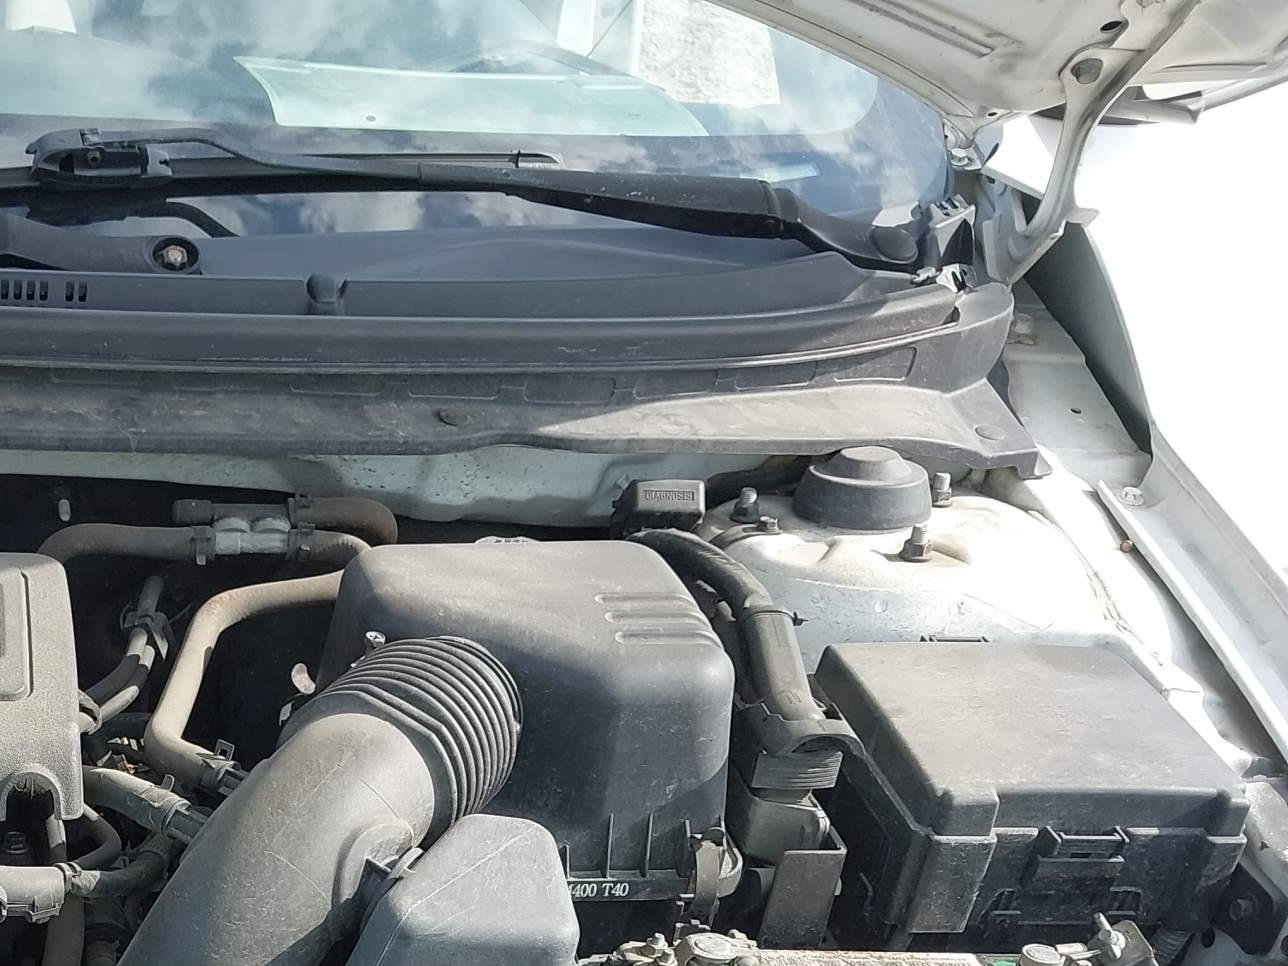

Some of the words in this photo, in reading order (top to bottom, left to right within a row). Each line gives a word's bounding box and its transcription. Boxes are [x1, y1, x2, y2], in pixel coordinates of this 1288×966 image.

[645, 491, 691, 501] DIAGNOSIS
[569, 883, 598, 897] 400
[602, 882, 630, 897] T40
